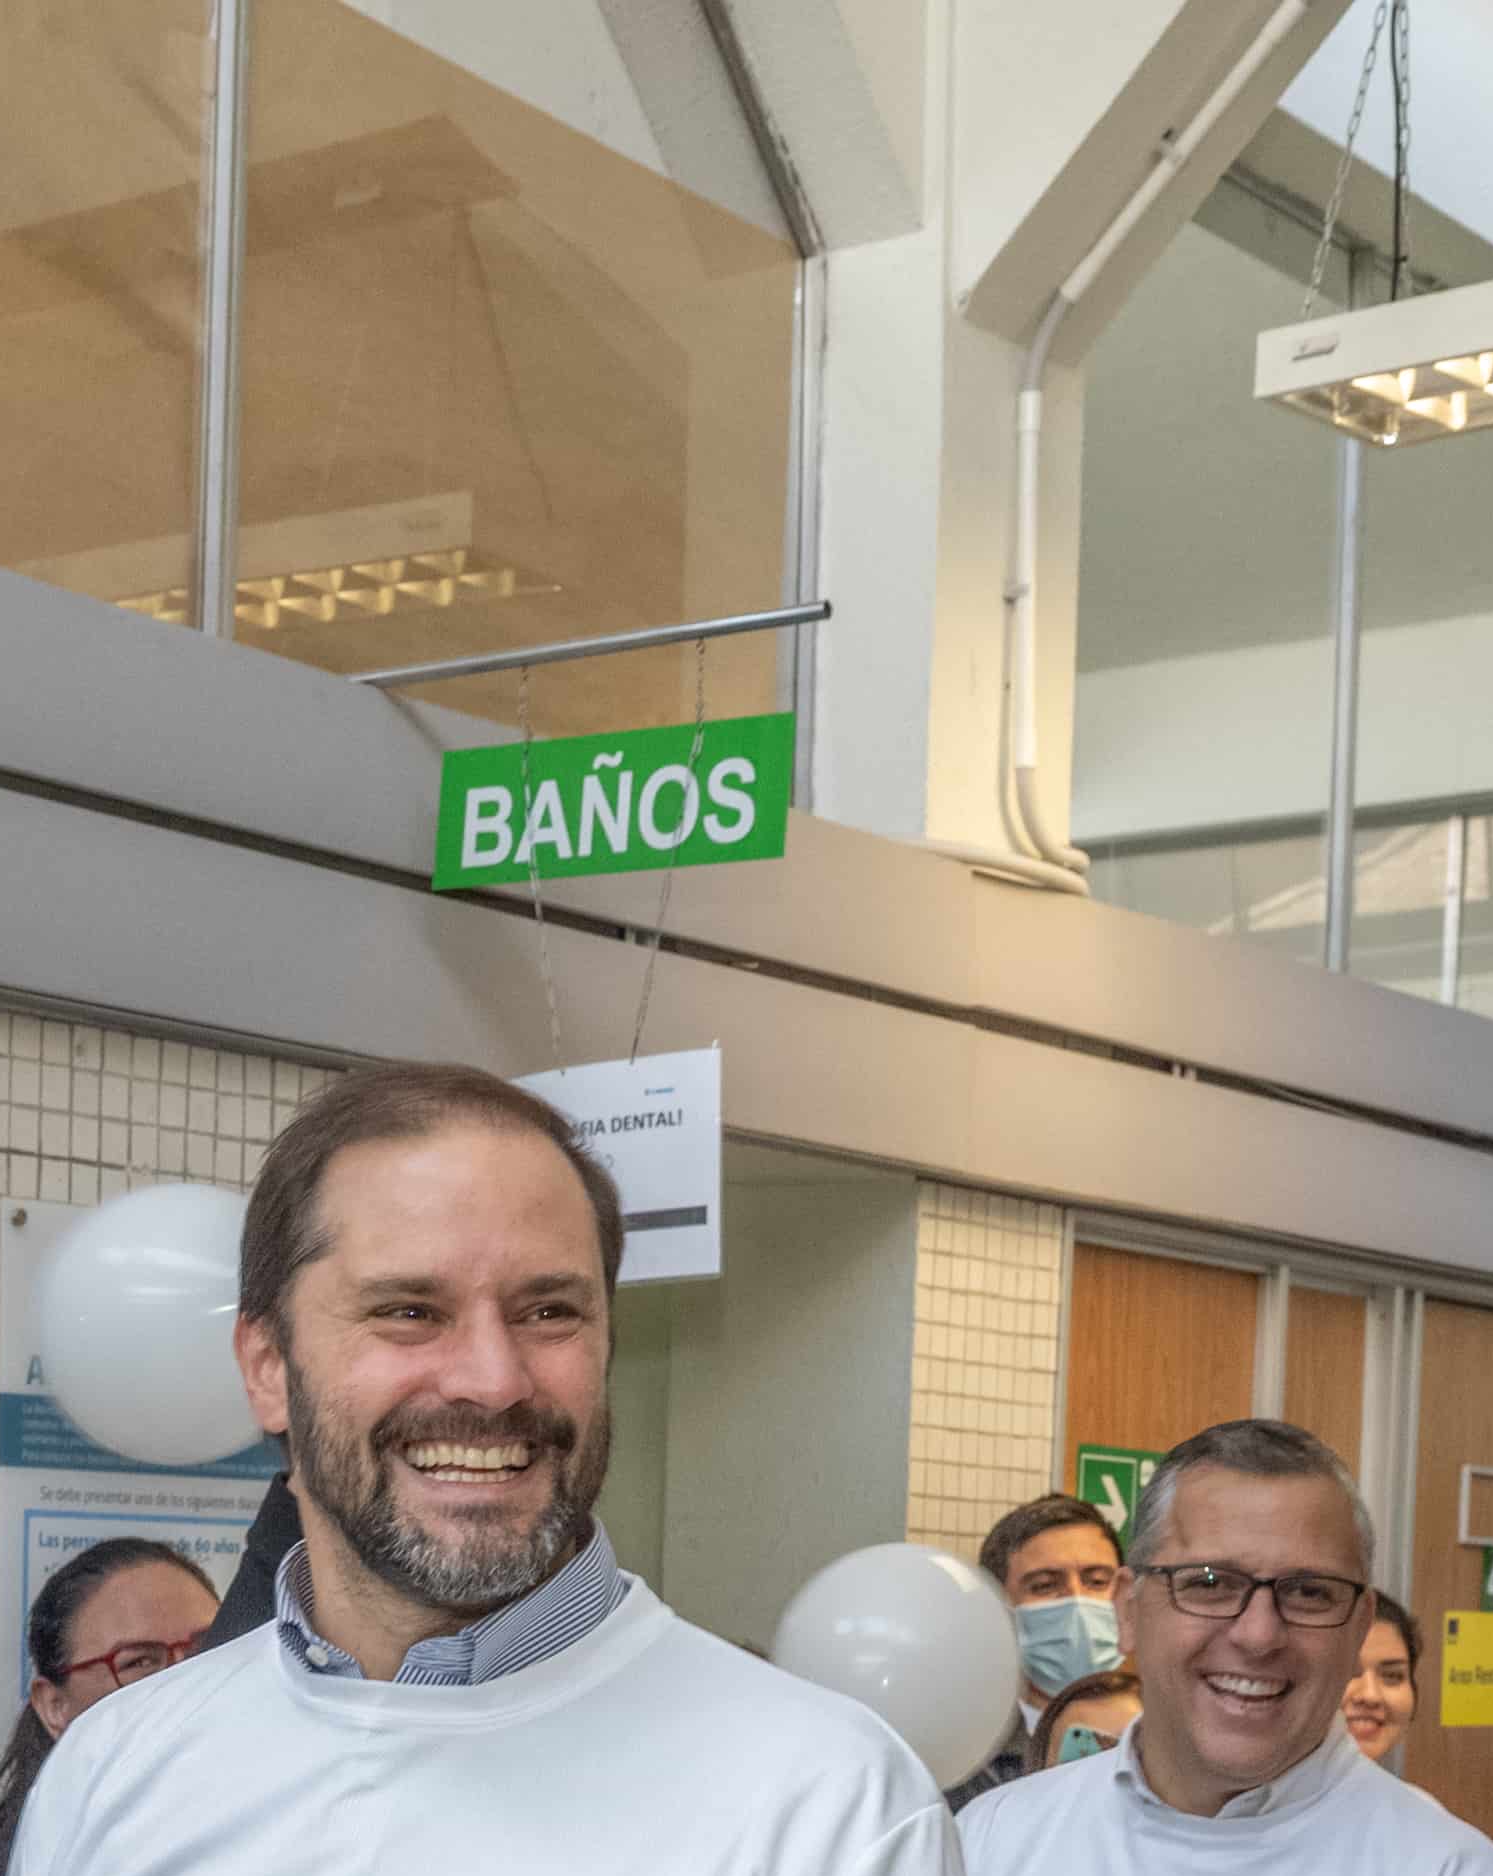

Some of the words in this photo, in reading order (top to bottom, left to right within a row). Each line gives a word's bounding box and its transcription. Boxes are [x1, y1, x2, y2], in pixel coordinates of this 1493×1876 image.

[459, 751, 757, 870] BAÑOS
[577, 1120, 605, 1138] FIA
[611, 1107, 683, 1134] DENTAL!
